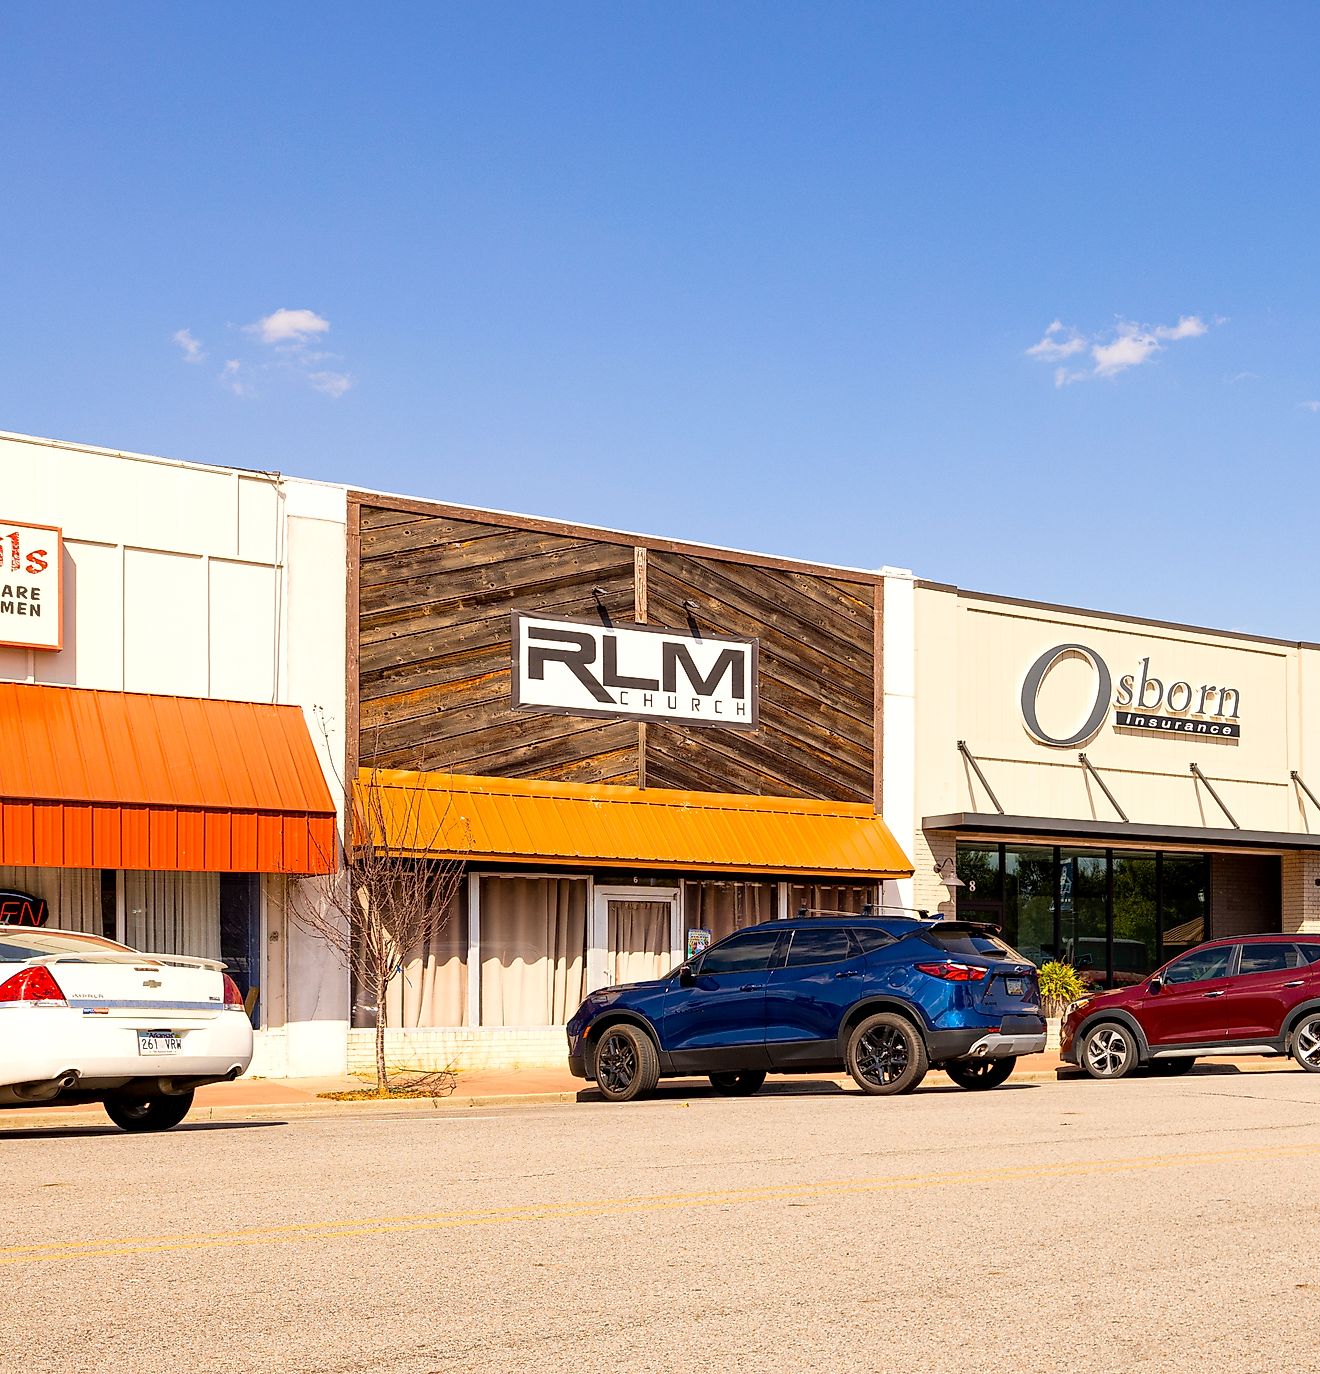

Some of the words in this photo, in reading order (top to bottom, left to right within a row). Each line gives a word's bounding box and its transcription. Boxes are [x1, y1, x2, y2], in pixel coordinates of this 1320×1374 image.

[528, 626, 744, 704] RLM
[620, 691, 745, 716] CHURCH
[1021, 644, 1240, 747] Osborn
[1126, 714, 1232, 735] Insurance
[969, 881, 976, 891] 8
[141, 1039, 158, 1050] 261
[165, 1039, 182, 1050] VRW
